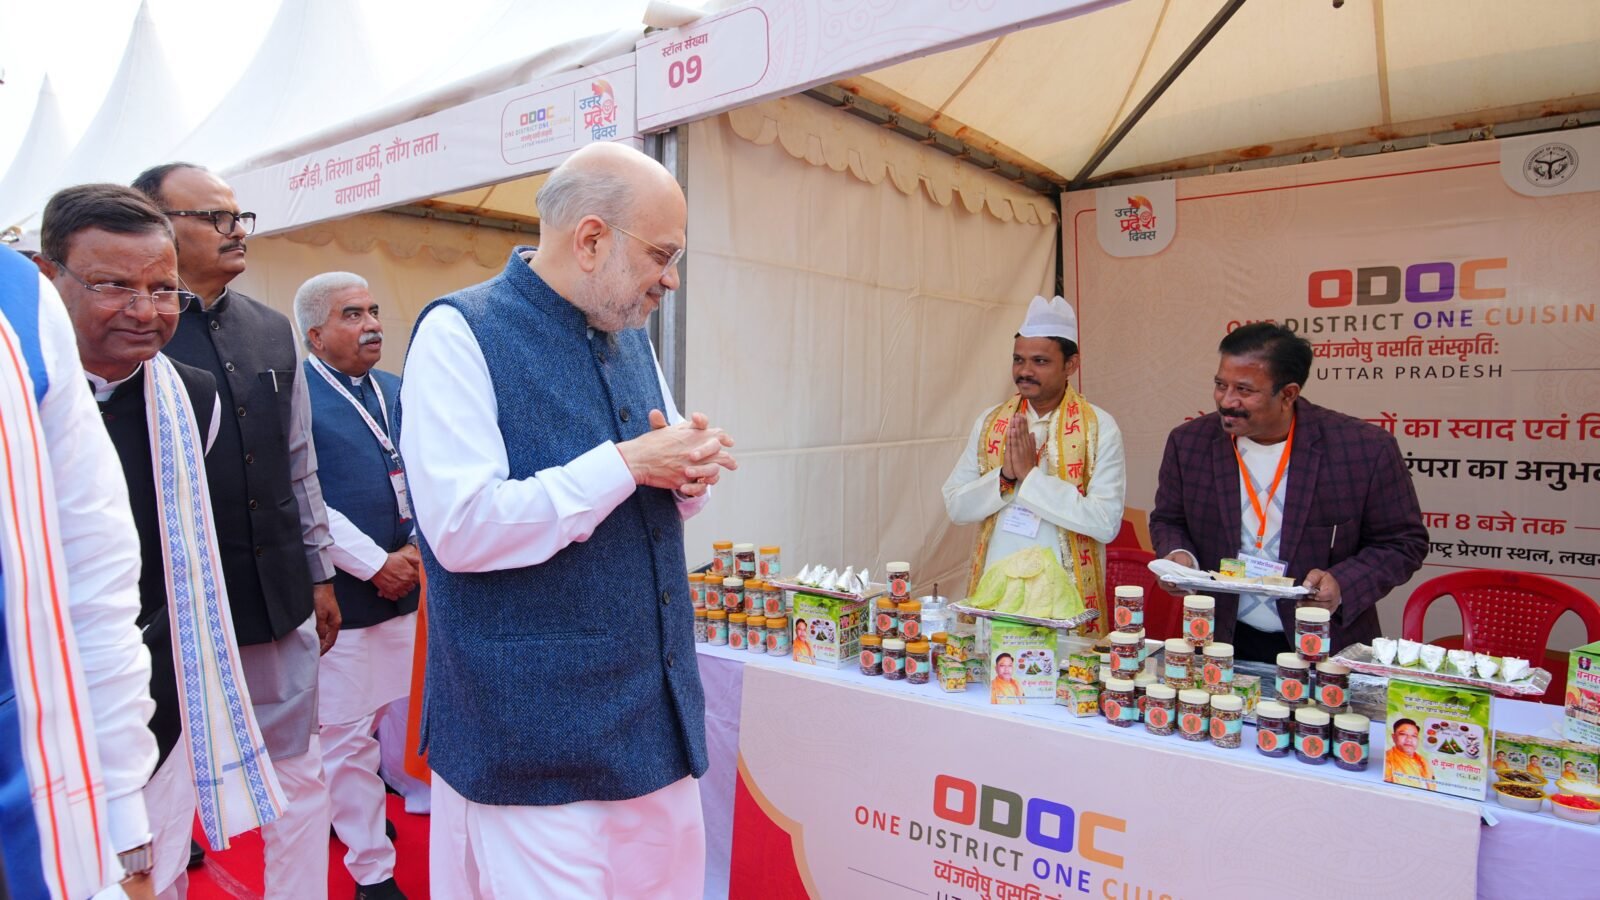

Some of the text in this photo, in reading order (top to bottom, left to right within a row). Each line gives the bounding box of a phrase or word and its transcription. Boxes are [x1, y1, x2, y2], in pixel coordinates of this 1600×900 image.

[661, 33, 708, 57] स्टॉल संख्या
[668, 55, 702, 88] 09
[578, 94, 602, 110] उत्तर
[520, 105, 554, 126] ODOC
[584, 102, 617, 129] प्रदेश
[591, 124, 617, 140] दिवस
[325, 157, 353, 182] तिरंगा
[385, 137, 410, 164] लौंग
[413, 132, 439, 157] लता
[335, 173, 381, 205] वाराणसी
[1114, 207, 1139, 217] उत्तर
[1120, 214, 1156, 232] प्रदेश
[1129, 229, 1157, 241] दिवस
[1308, 257, 1508, 308] ODOC
[1285, 313, 1404, 334] DISTRICT
[1413, 309, 1473, 330] ONE
[1312, 338, 1373, 363] व्यंजनेषु
[1376, 335, 1424, 358] वसति
[1317, 364, 1502, 380] UTTAR PRADESH
[1403, 418, 1442, 438] का
[1447, 418, 1517, 441] स्वाद
[1522, 413, 1570, 441] एवं
[1404, 451, 1461, 478] रंपरा
[1467, 460, 1508, 480] का
[1455, 514, 1470, 530] 8
[1476, 511, 1517, 533] बजे
[1521, 517, 1567, 535] तक
[1457, 540, 1503, 559] प्रेरणा
[1506, 547, 1553, 565] स्थल,
[933, 774, 1126, 870] ODOC
[855, 806, 901, 836] ONE
[909, 820, 1024, 872] DISTRICT
[1032, 857, 1091, 893] ONE
